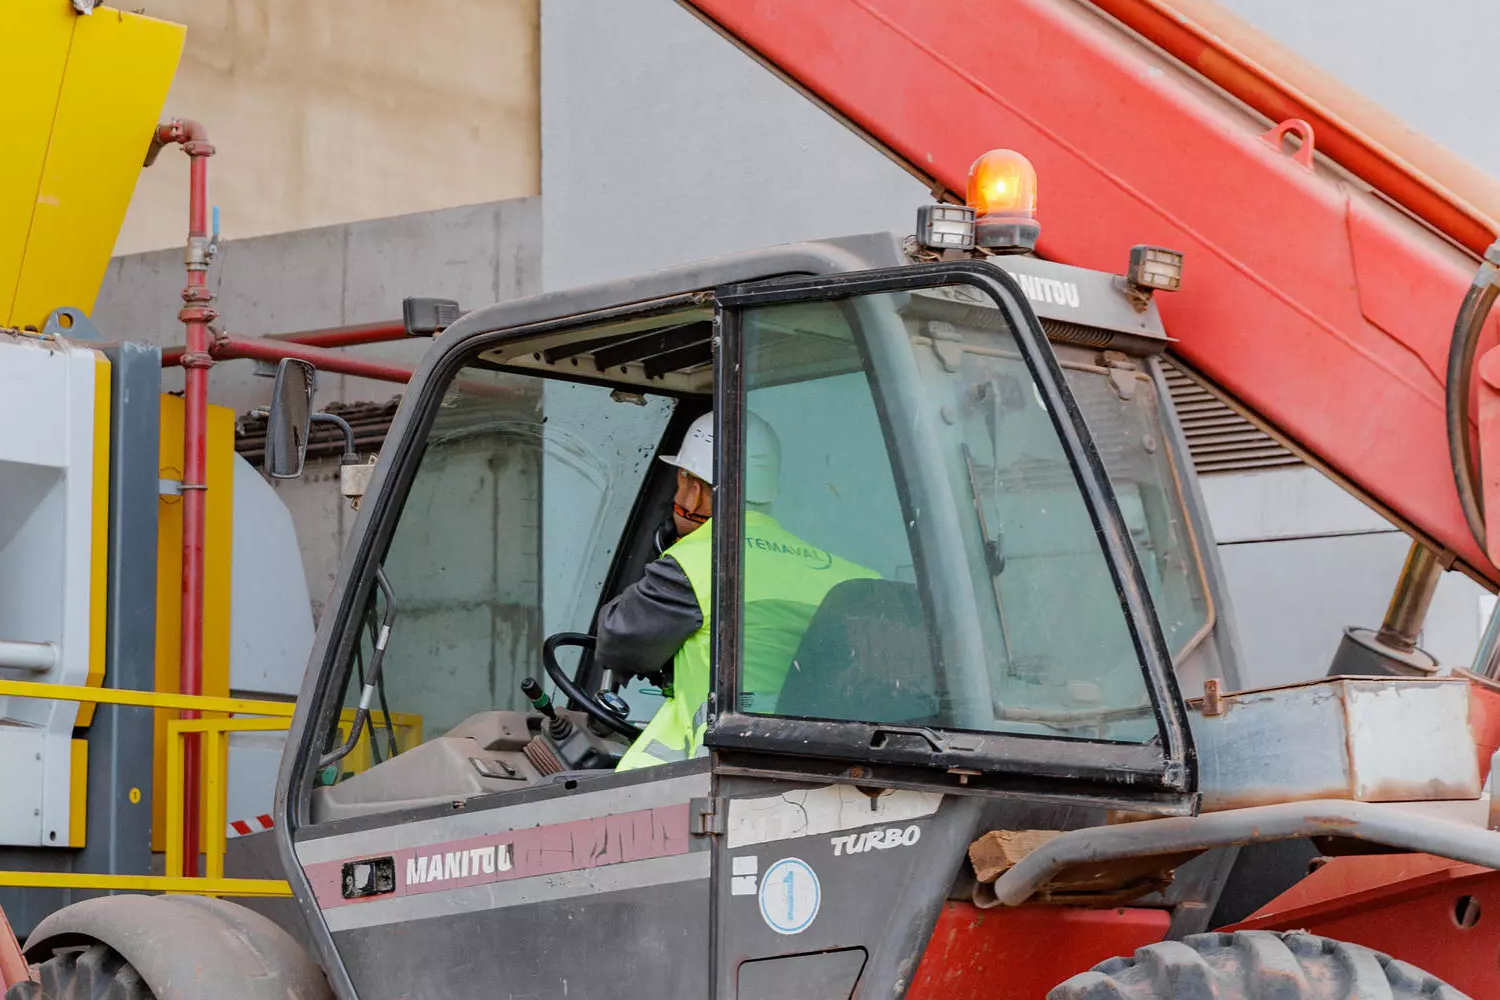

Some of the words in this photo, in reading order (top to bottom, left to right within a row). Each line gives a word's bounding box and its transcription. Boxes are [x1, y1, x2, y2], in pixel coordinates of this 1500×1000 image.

[1008, 271, 1080, 308] NITOU
[831, 825, 921, 856] TURBO
[406, 844, 513, 885] MANITOU
[782, 870, 794, 921] 1
